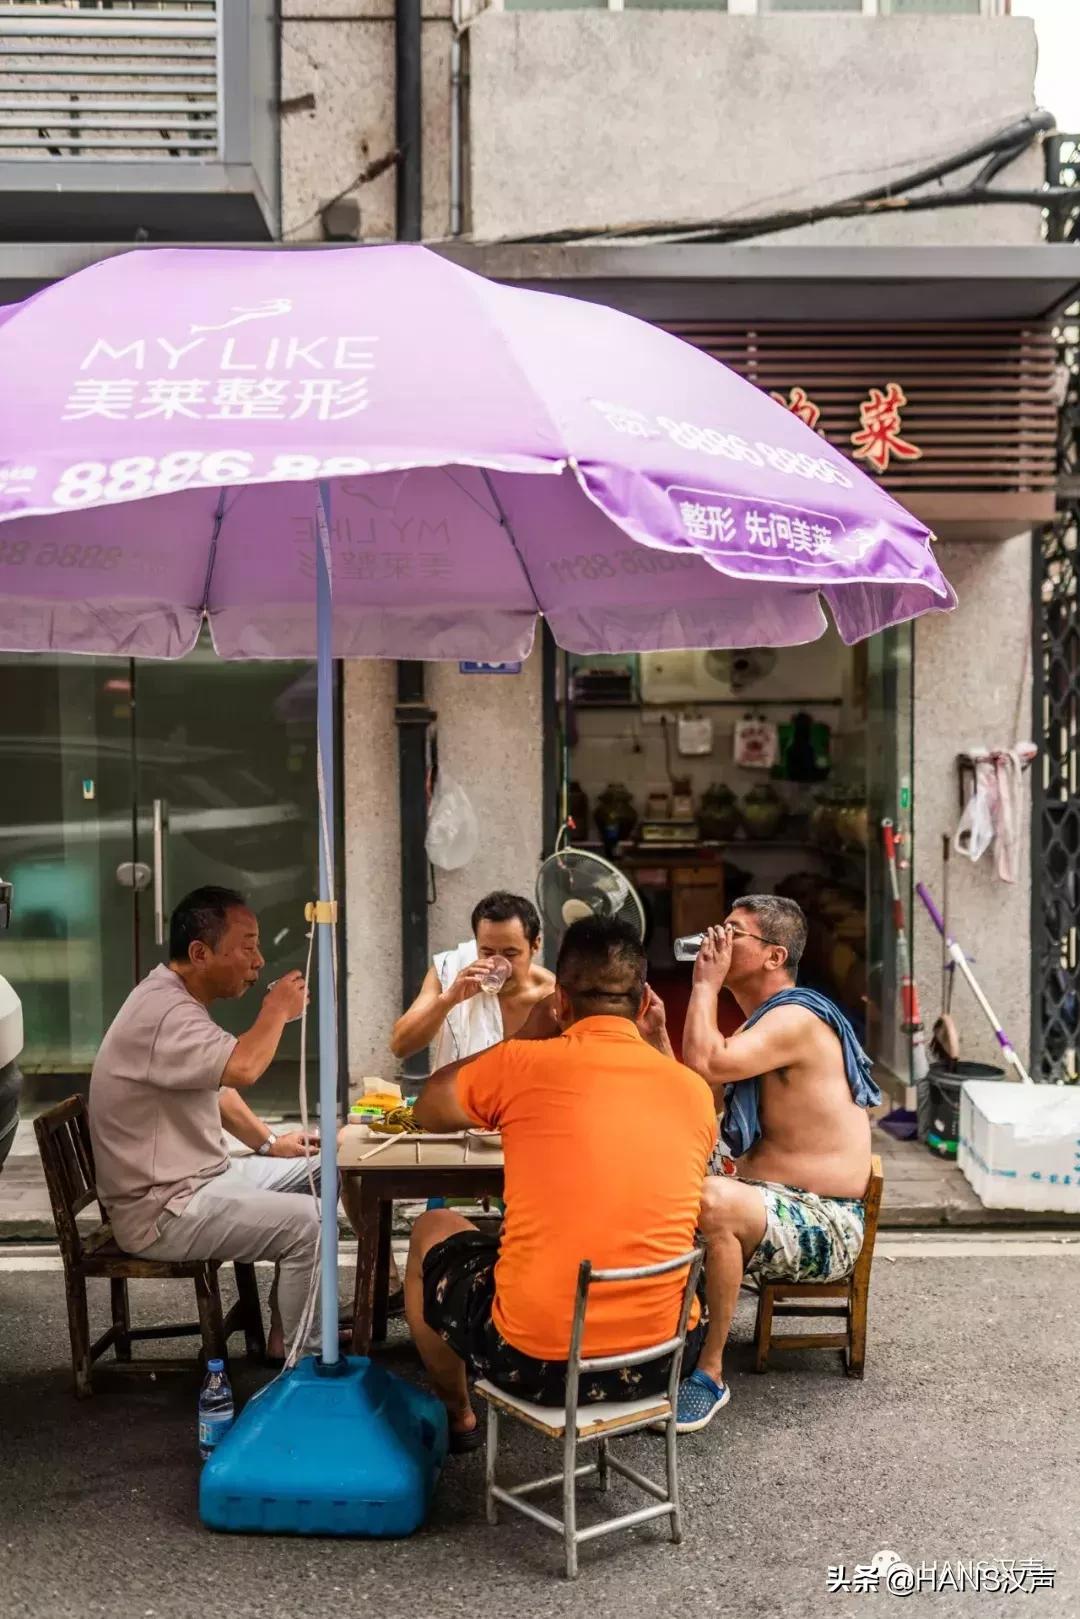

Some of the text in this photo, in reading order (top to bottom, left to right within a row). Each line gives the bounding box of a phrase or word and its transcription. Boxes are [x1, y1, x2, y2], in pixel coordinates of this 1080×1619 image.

[79, 335, 380, 371] MY LIKE
[60, 376, 369, 421] 美莱整形
[51, 449, 254, 506] 8886
[679, 500, 840, 556] 整形 先问美莱
